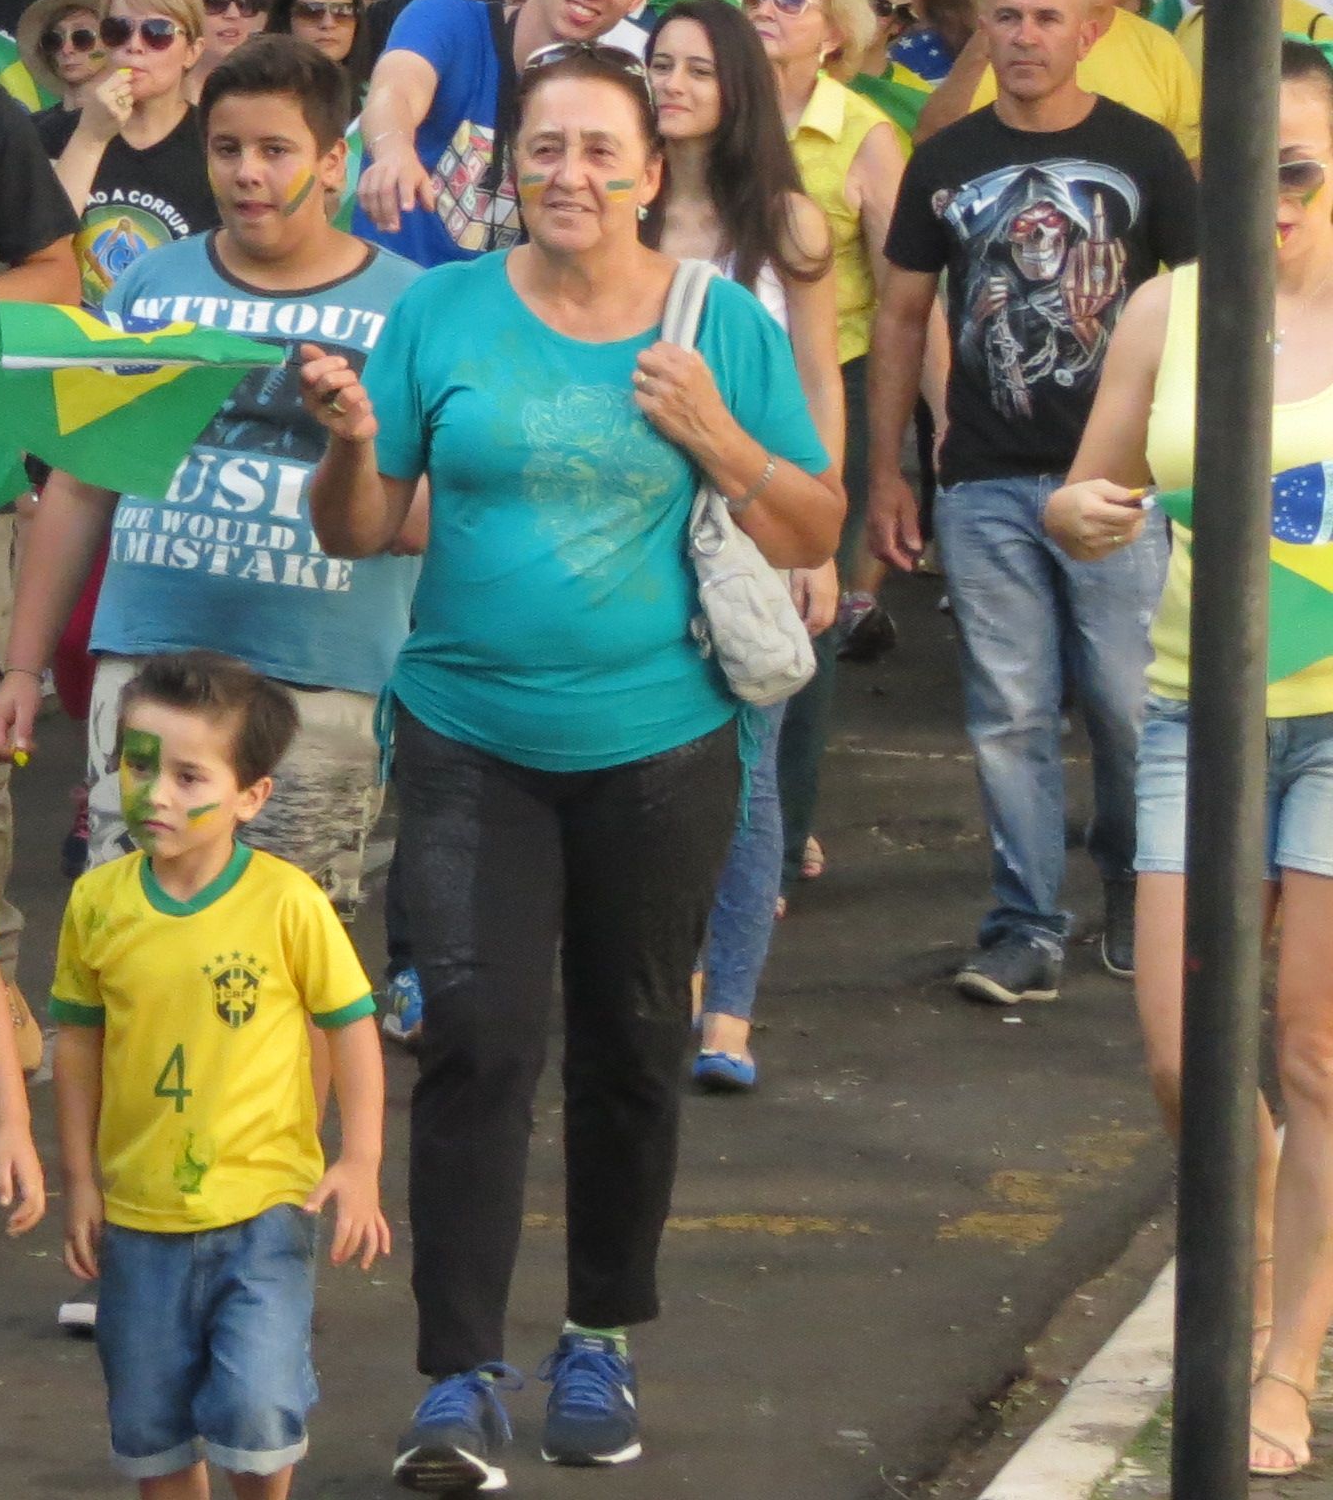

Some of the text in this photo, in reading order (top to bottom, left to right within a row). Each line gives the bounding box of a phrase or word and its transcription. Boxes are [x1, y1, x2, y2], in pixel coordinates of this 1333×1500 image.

[112, 188, 125, 202] A
[128, 190, 190, 238] CORRUP
[131, 296, 386, 349] WITHOUT
[164, 453, 311, 520] USI
[161, 509, 295, 551] WOULD
[124, 532, 354, 592] MISTAKE
[154, 1042, 193, 1113] 4
